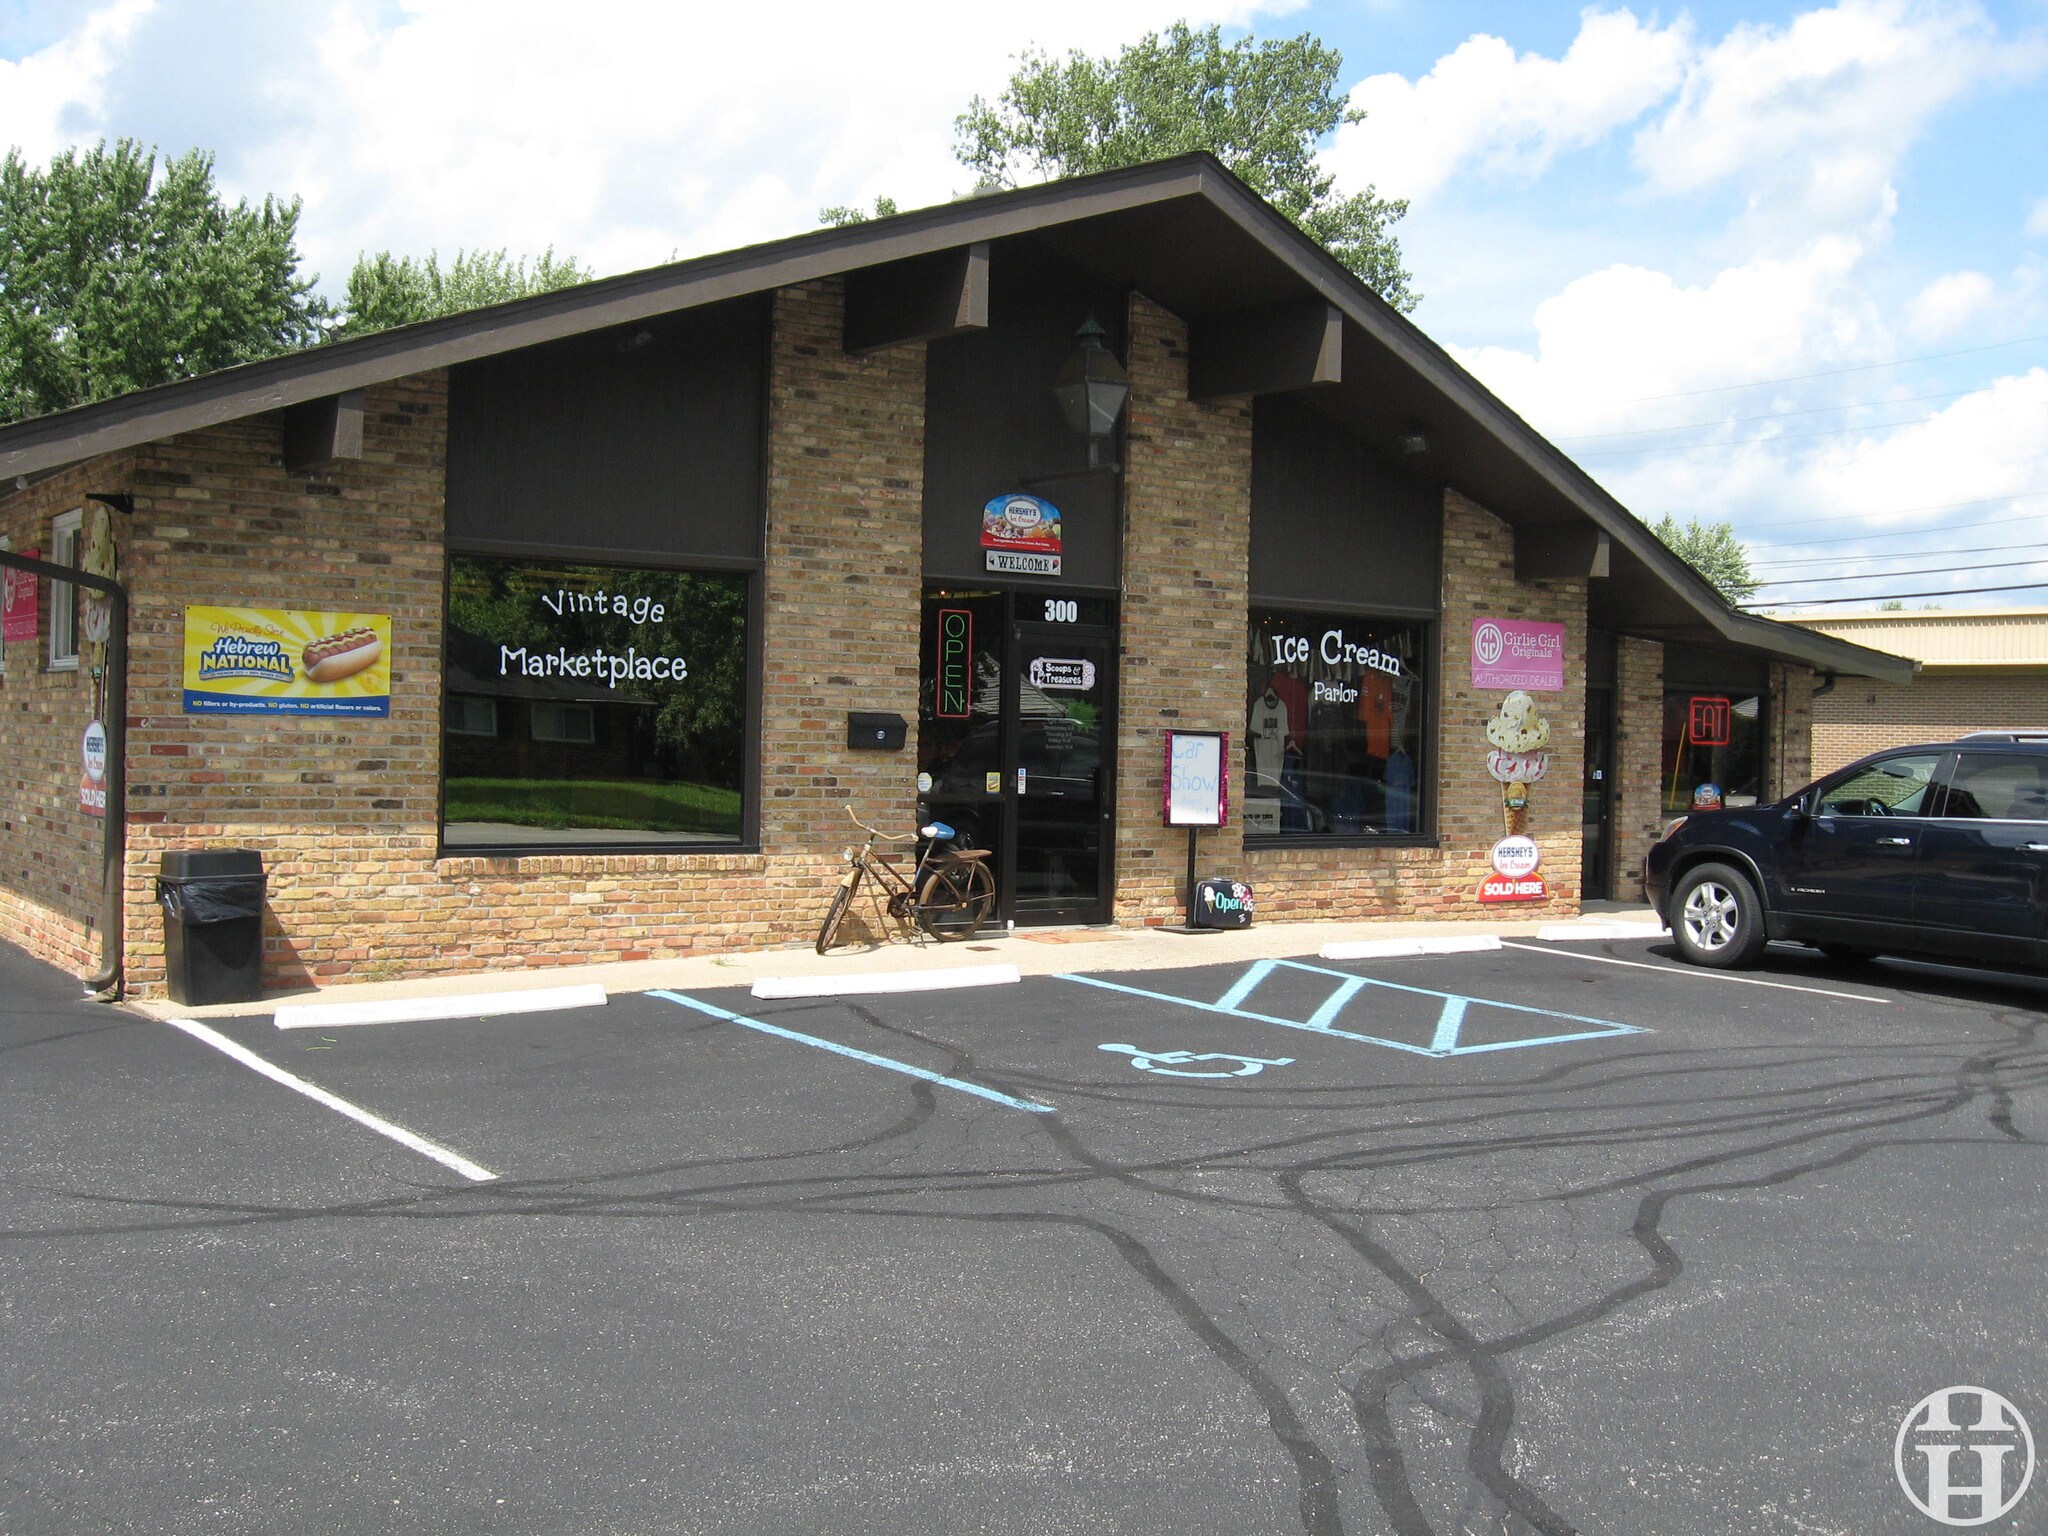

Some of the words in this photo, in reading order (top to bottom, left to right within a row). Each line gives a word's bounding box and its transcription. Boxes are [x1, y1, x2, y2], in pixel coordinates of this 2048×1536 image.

[998, 556, 1049, 572] WELCOME
[541, 588, 665, 624] Vintage
[1044, 599, 1078, 623] 300
[214, 637, 278, 655] Hebrew
[1504, 631, 1536, 646] Girlie
[1538, 633, 1560, 648] Girl
[1271, 634, 1310, 665] Ice
[1320, 629, 1401, 677] Cream
[1511, 646, 1552, 660] Originals
[203, 653, 290, 674] NATIONAL
[499, 644, 688, 689] Marketplace
[944, 614, 965, 712] OPEN
[1045, 663, 1072, 674] Scoops
[1073, 666, 1081, 675] &
[1045, 673, 1082, 684] Treasures
[1475, 672, 1527, 685] AUTHORIZED
[1530, 675, 1559, 687] DEALER
[1313, 681, 1358, 703] Parlor
[229, 701, 267, 709] by-products.
[1692, 705, 1725, 738] EAT
[1172, 735, 1204, 758] Car
[1172, 765, 1218, 791] Show
[81, 788, 95, 805] SOLD
[1498, 847, 1533, 858] HERSHEY'S
[1500, 860, 1508, 869] Ice
[1510, 860, 1531, 870] Cream
[1484, 882, 1513, 896] SOLD
[1515, 882, 1543, 895] HERE
[1215, 892, 1243, 914] Open
